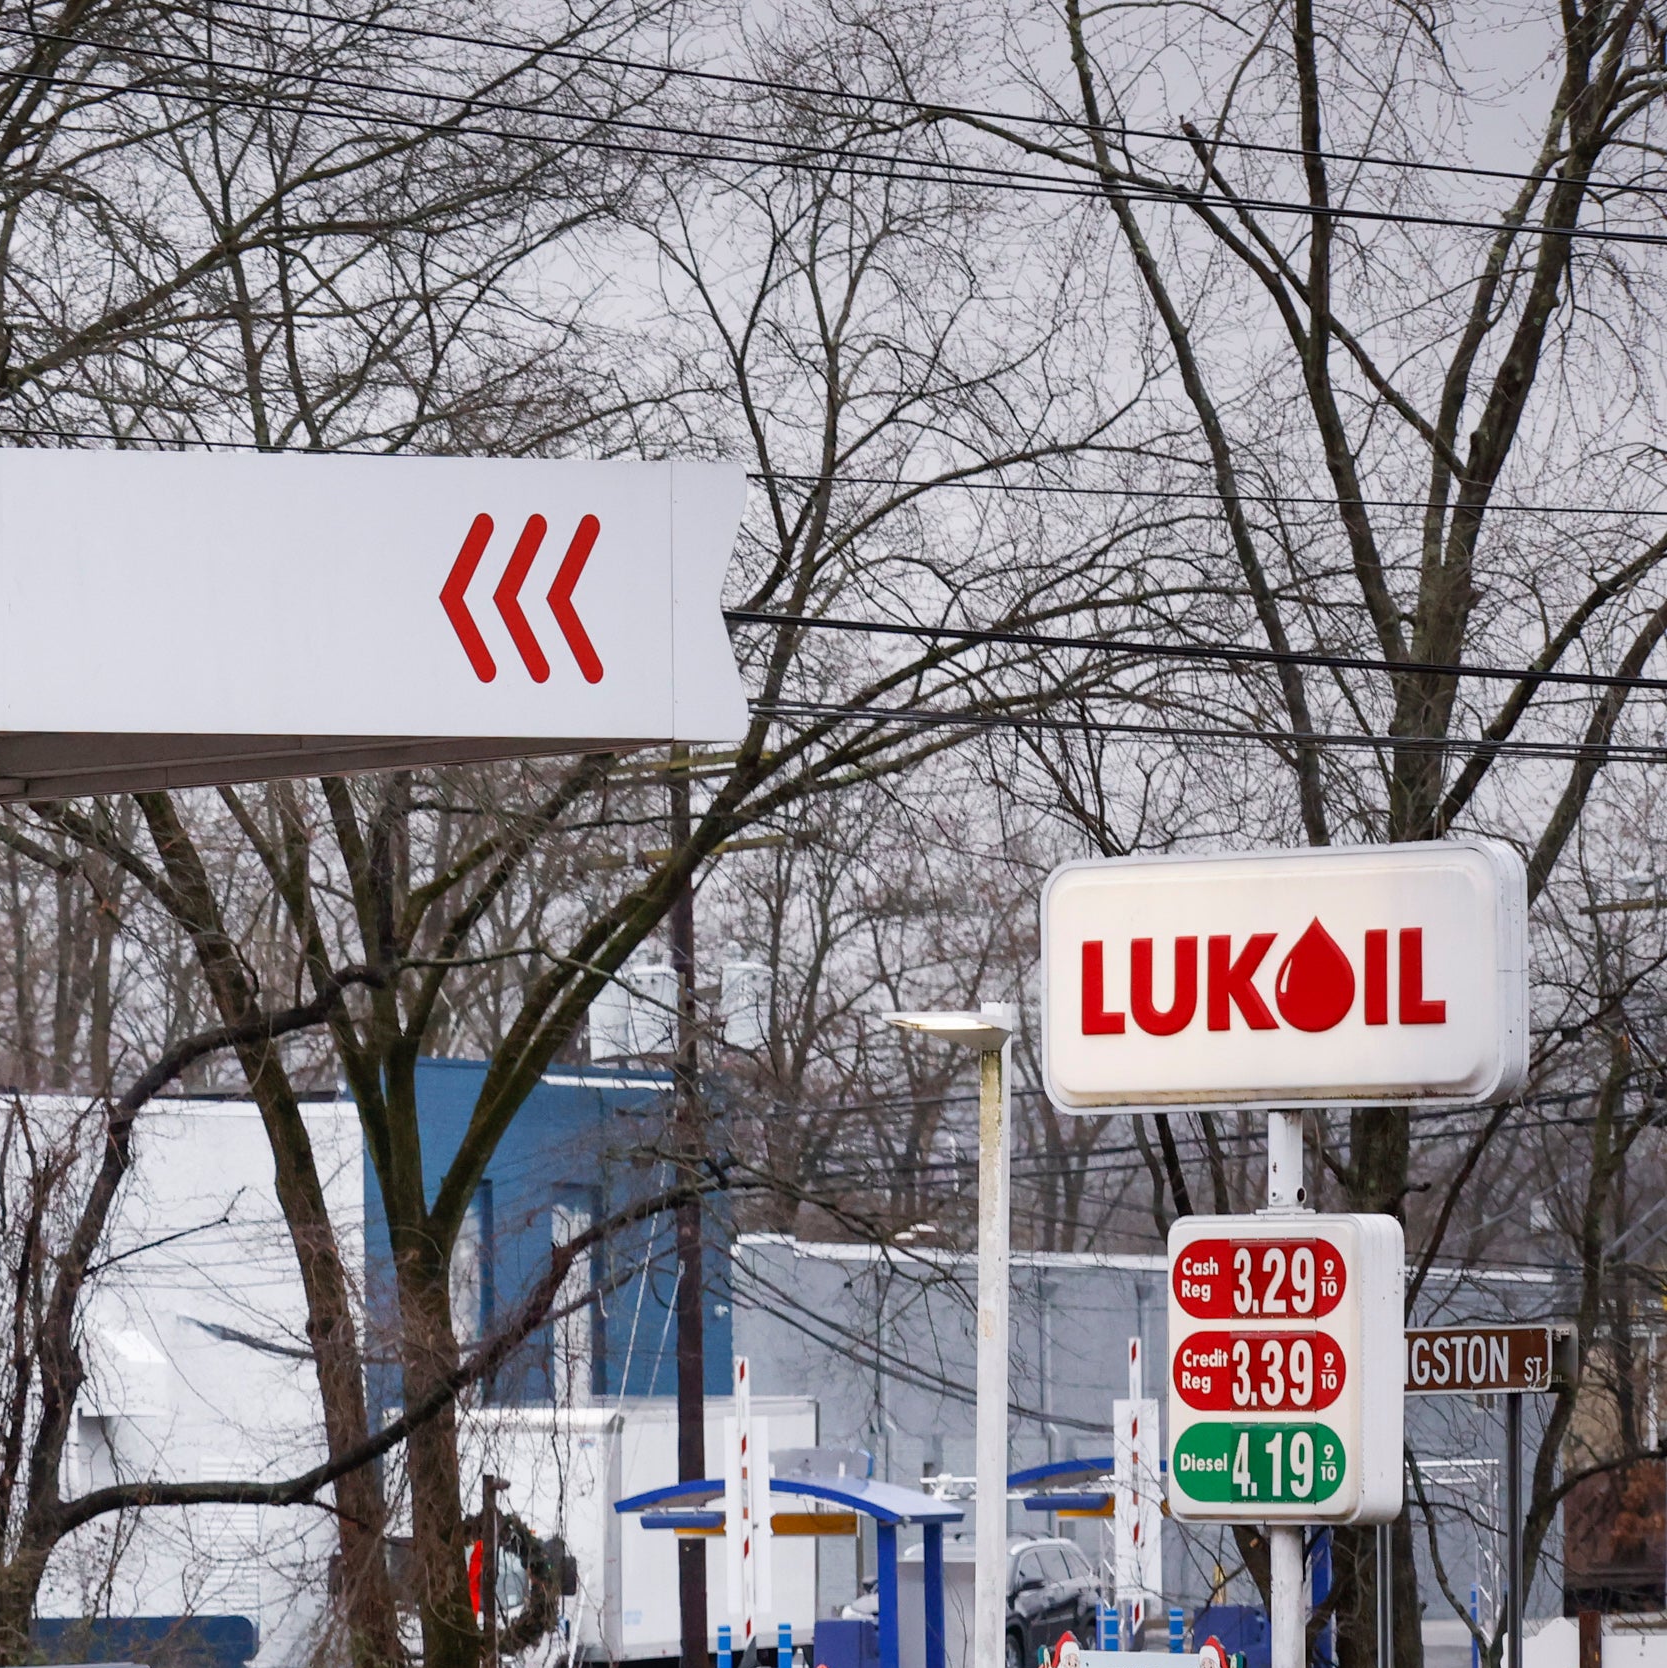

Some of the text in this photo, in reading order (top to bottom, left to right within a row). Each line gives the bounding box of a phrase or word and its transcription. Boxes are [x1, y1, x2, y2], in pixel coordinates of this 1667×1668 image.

[1081, 916, 1447, 1036] LUKOIL
[1181, 1257, 1219, 1277] Cash
[1181, 1281, 1212, 1302] Reg
[1232, 1247, 1316, 1315] 3.29
[1181, 1348, 1229, 1368] Credit
[1523, 1356, 1543, 1383] ST
[1181, 1371, 1212, 1394] Reg
[1231, 1339, 1314, 1407] 3.39
[1180, 1431, 1314, 1499] Diesel 4.19
